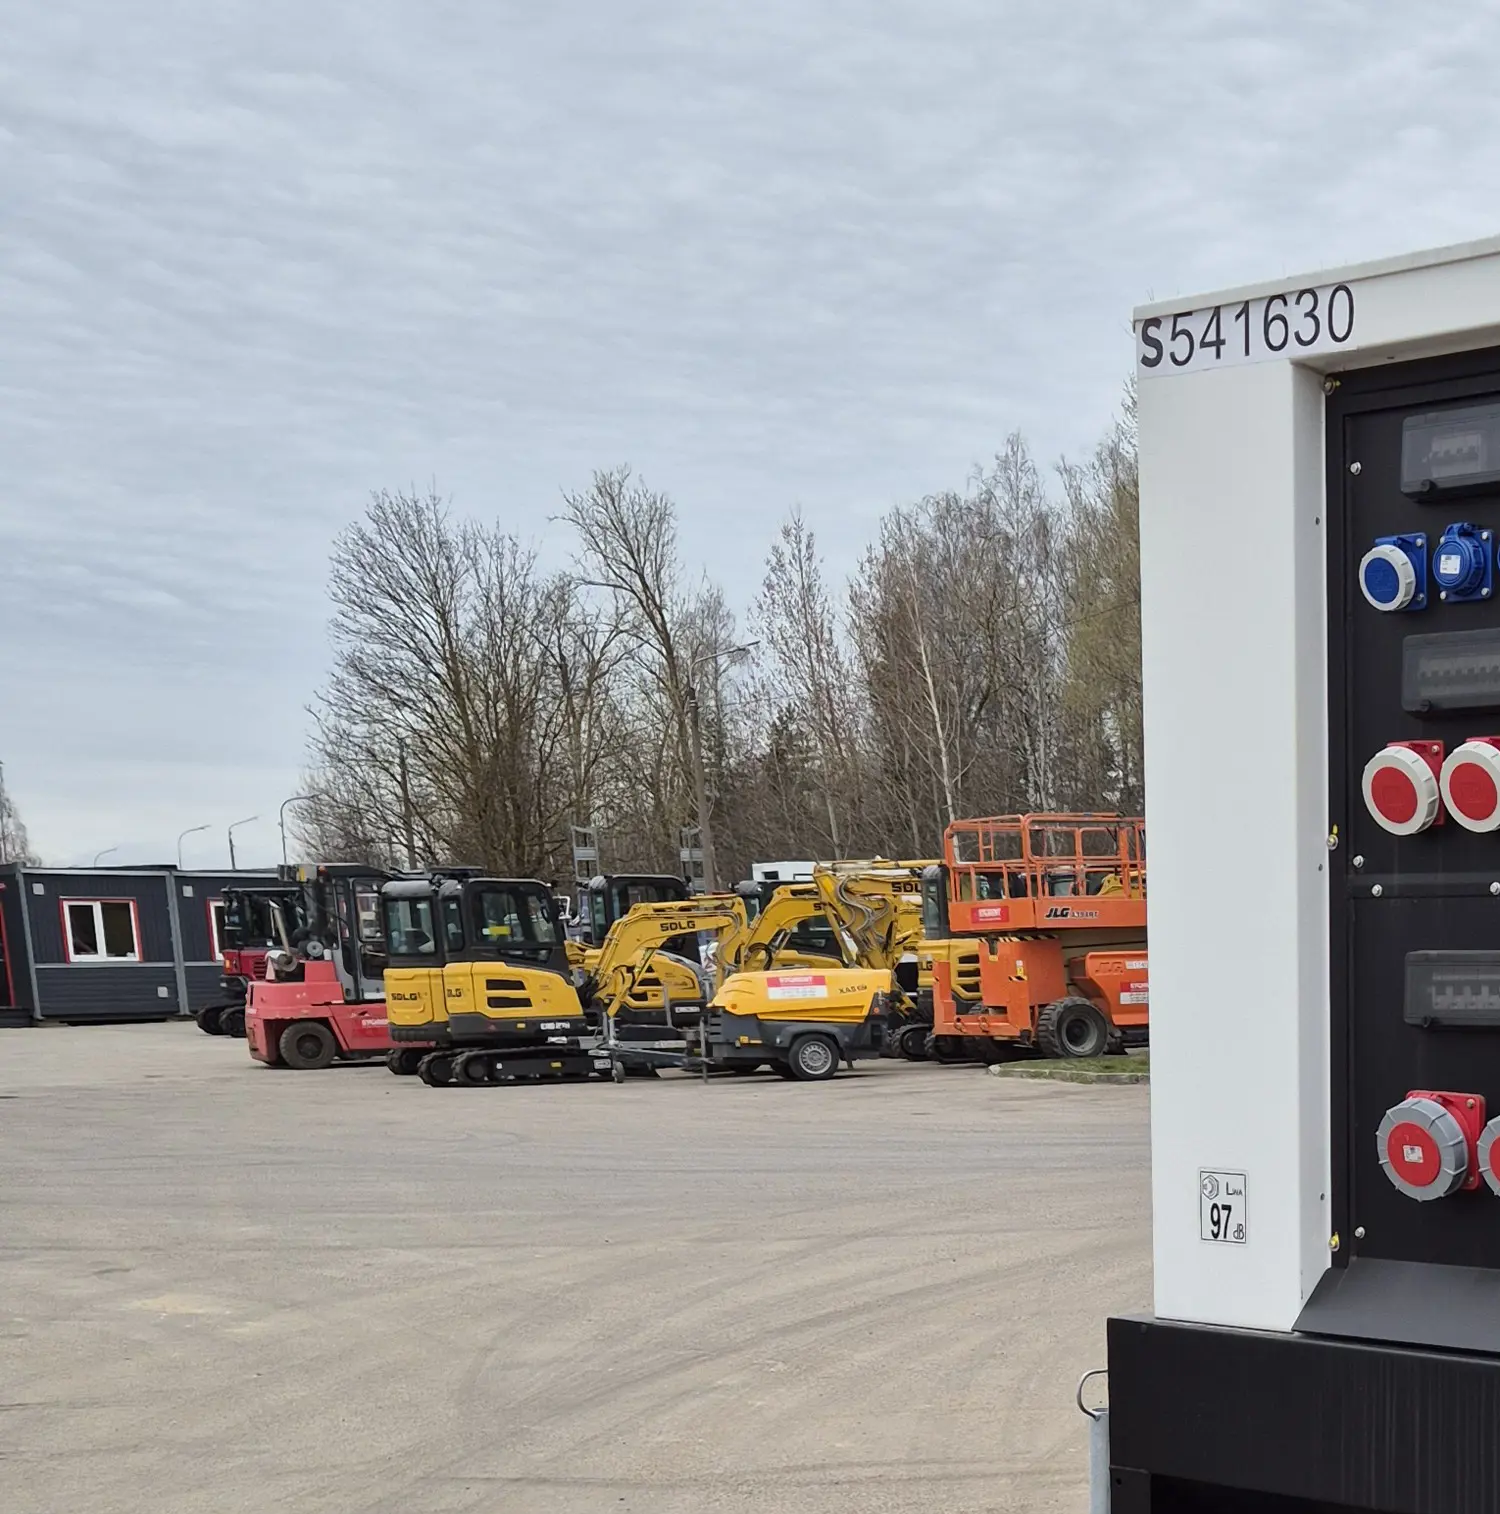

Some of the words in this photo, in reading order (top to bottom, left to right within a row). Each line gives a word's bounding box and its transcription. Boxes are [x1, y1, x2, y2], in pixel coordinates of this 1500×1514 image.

[1140, 284, 1355, 368] S541630
[1045, 907, 1070, 918] JLG
[660, 921, 696, 932] SDLG
[1211, 1203, 1232, 1239] 97
[1233, 1223, 1244, 1240] dB
